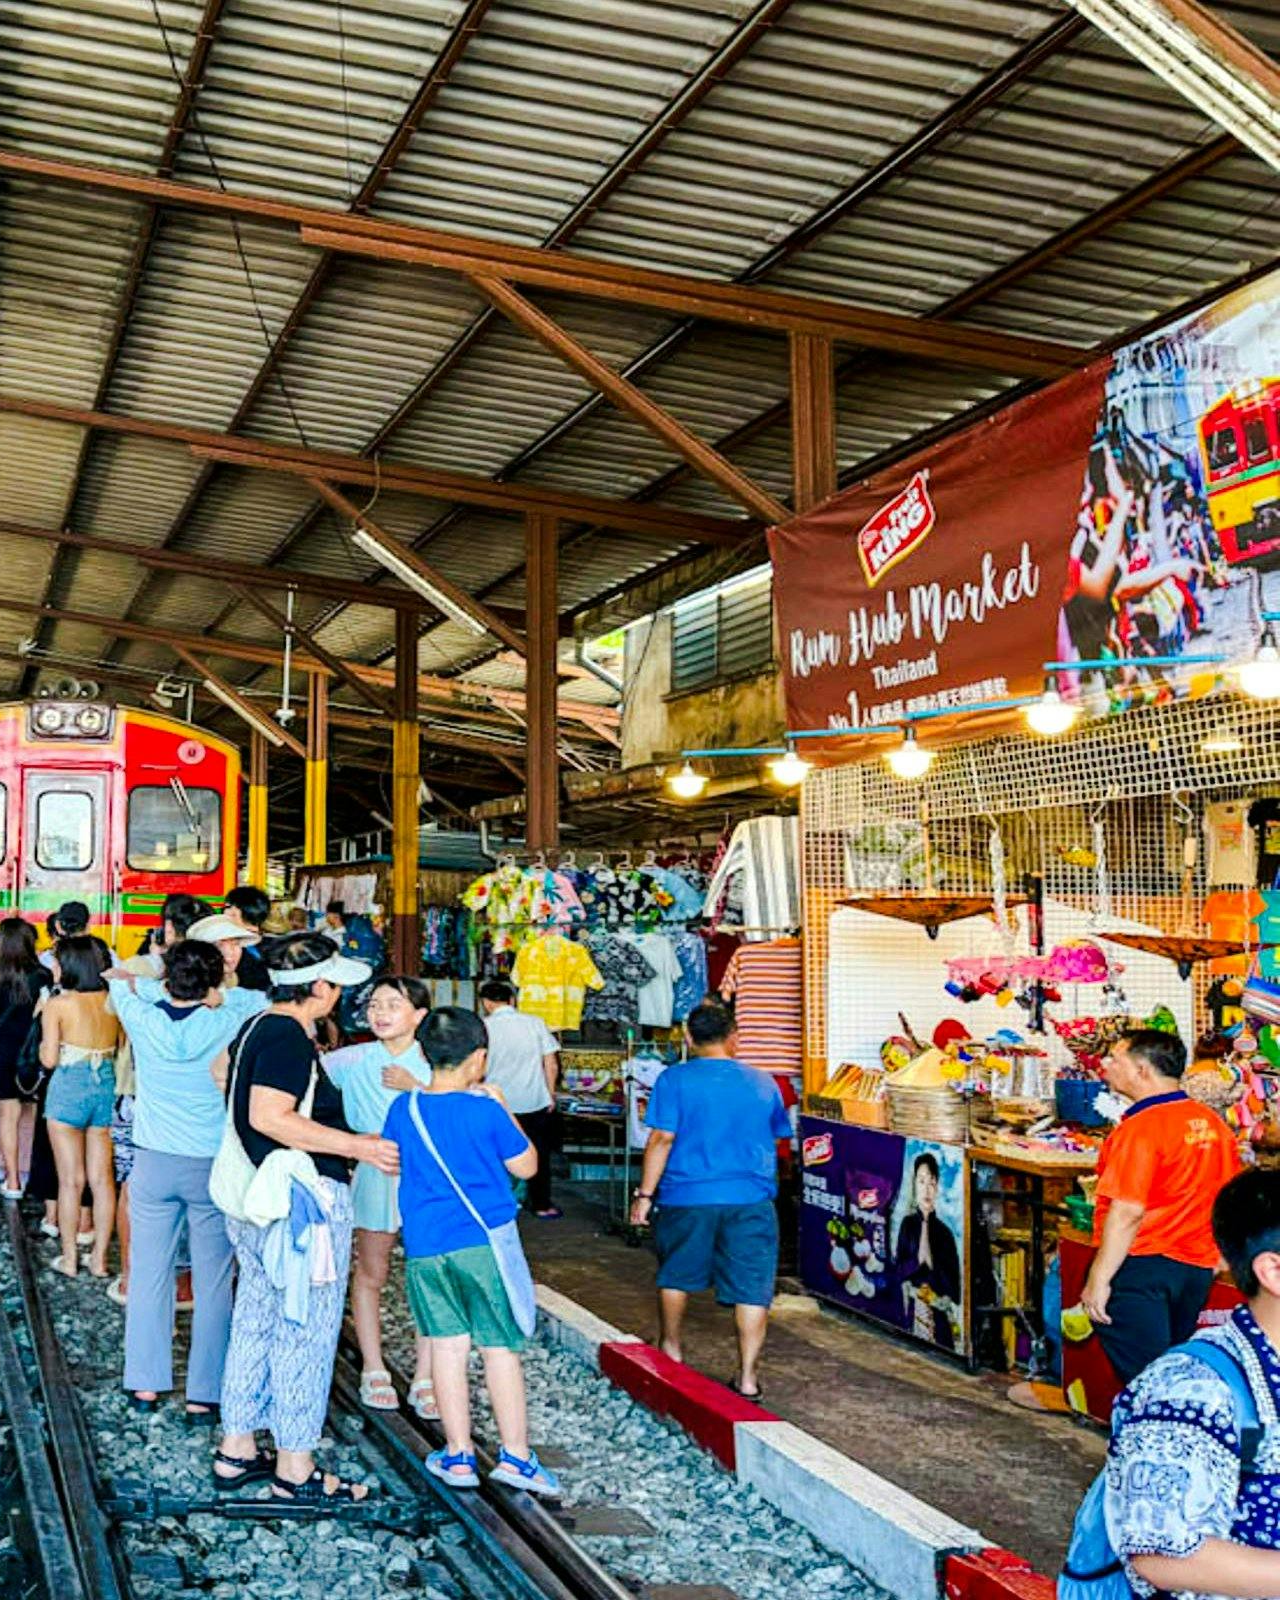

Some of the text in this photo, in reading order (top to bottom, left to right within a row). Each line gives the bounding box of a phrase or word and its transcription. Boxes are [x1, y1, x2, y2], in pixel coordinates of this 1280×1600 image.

[848, 590, 908, 667] Hub
[909, 541, 1040, 643] Market
[872, 650, 939, 690] Thailand
